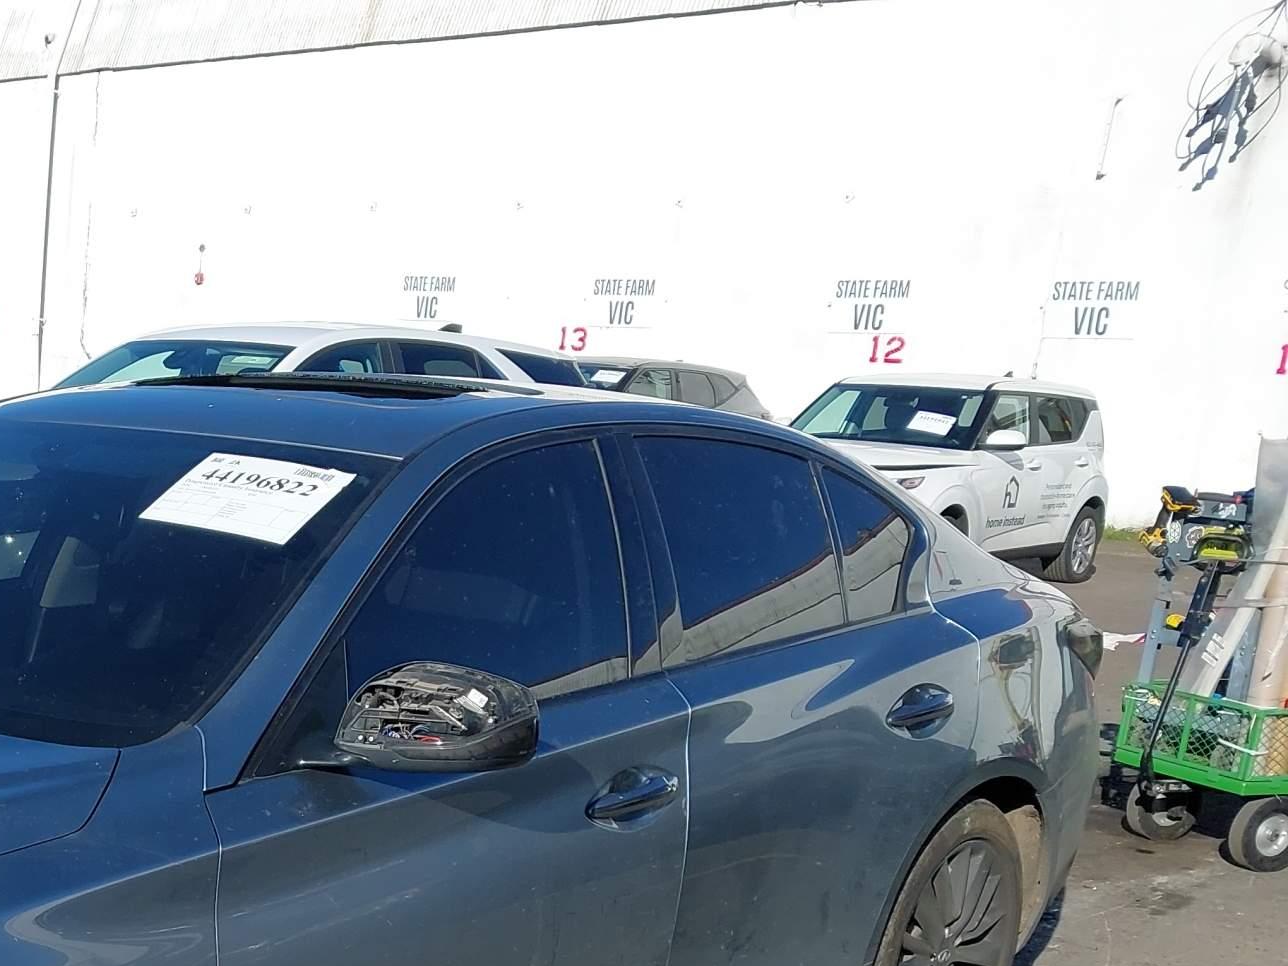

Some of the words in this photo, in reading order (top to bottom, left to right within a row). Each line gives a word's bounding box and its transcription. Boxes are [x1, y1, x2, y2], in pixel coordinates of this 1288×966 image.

[403, 275, 429, 292] STATE
[429, 276, 457, 293] FARM
[593, 279, 623, 297] STATE
[624, 279, 656, 297] FARM
[835, 279, 872, 299] STATE
[873, 279, 912, 299] FARM
[1052, 281, 1095, 301] STATE
[1096, 281, 1141, 301] FARM
[416, 296, 439, 319] VIC
[608, 300, 635, 326] VIC
[853, 303, 885, 331] VIC
[1073, 306, 1111, 336] VIC
[558, 326, 588, 352] 13
[868, 335, 906, 364] 12
[201, 467, 319, 497] 44196822
[985, 515, 1002, 528] home
[1002, 514, 1026, 527] instead
